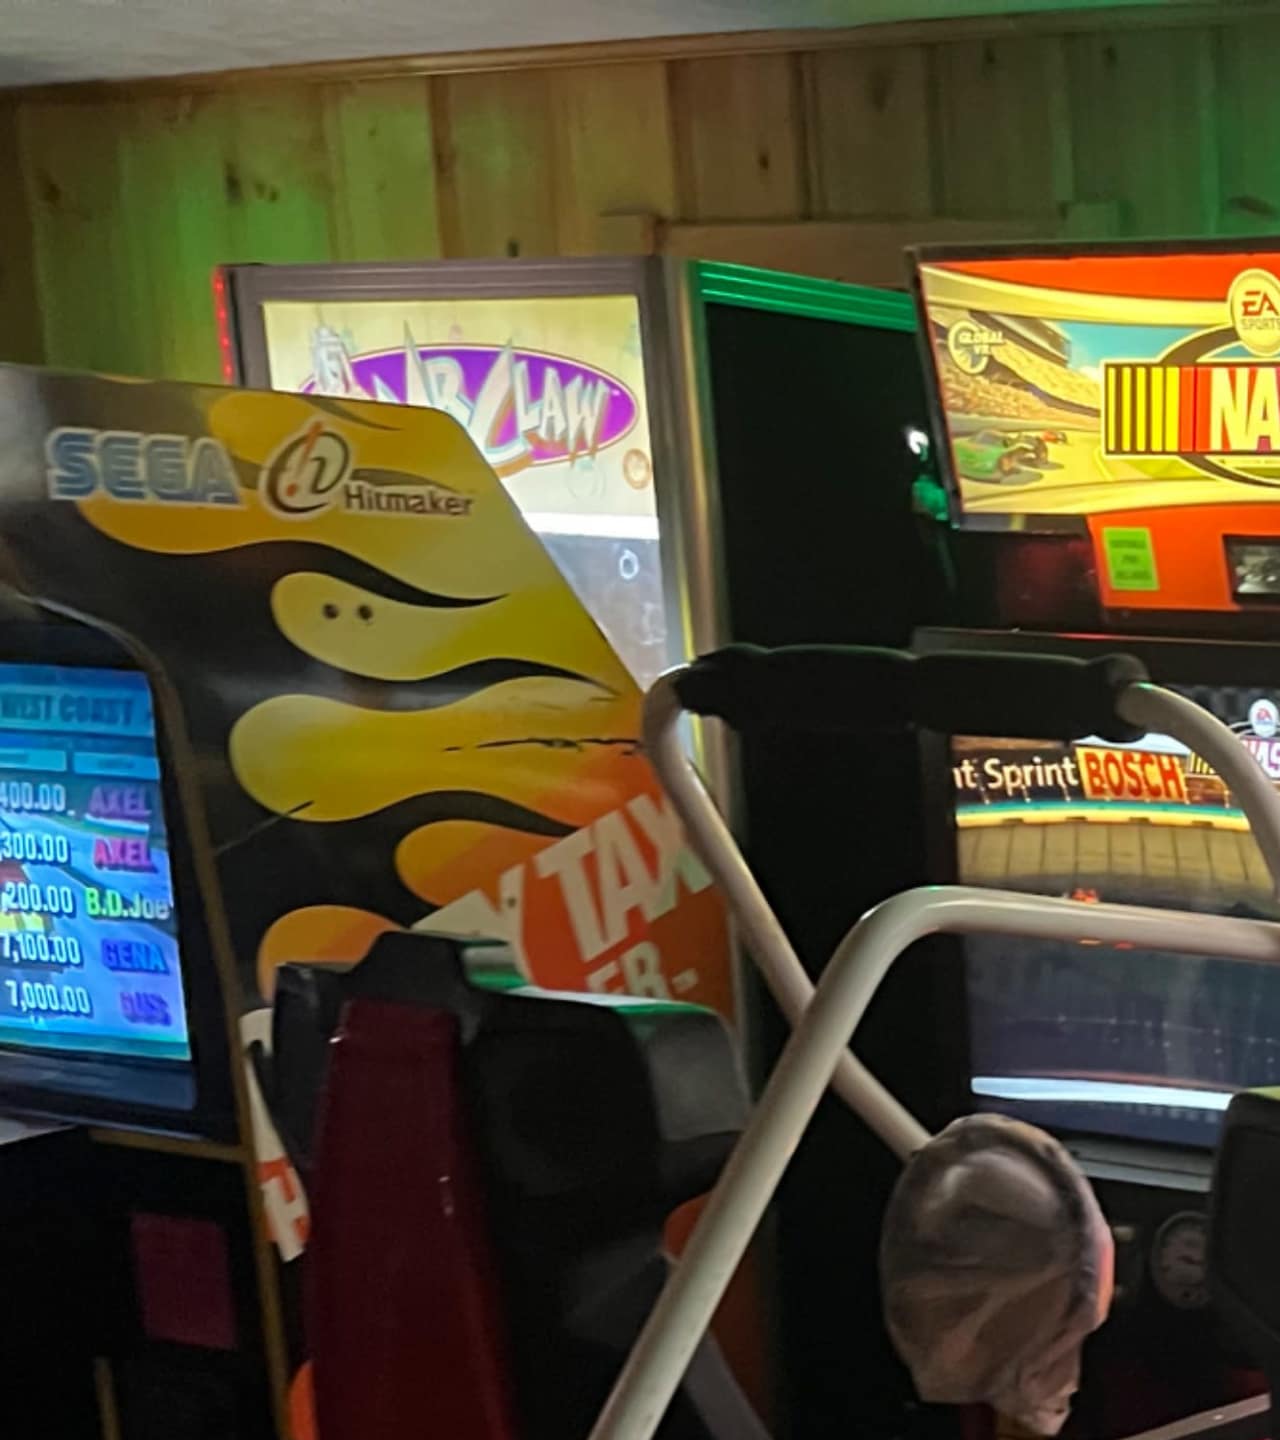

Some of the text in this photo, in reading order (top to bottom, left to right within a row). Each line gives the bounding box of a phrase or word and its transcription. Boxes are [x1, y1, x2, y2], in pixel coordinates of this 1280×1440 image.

[1241, 290, 1280, 317] EA
[45, 427, 246, 508] SEGA
[343, 484, 475, 517] Hitmaker
[982, 756, 1077, 797] Sprint
[1084, 749, 1183, 799] BOSCH
[94, 836, 153, 867] AXEL
[533, 792, 715, 963] TAX
[0, 930, 168, 971] 7,100.00 GENA
[5, 978, 91, 1014] 7,000.00
